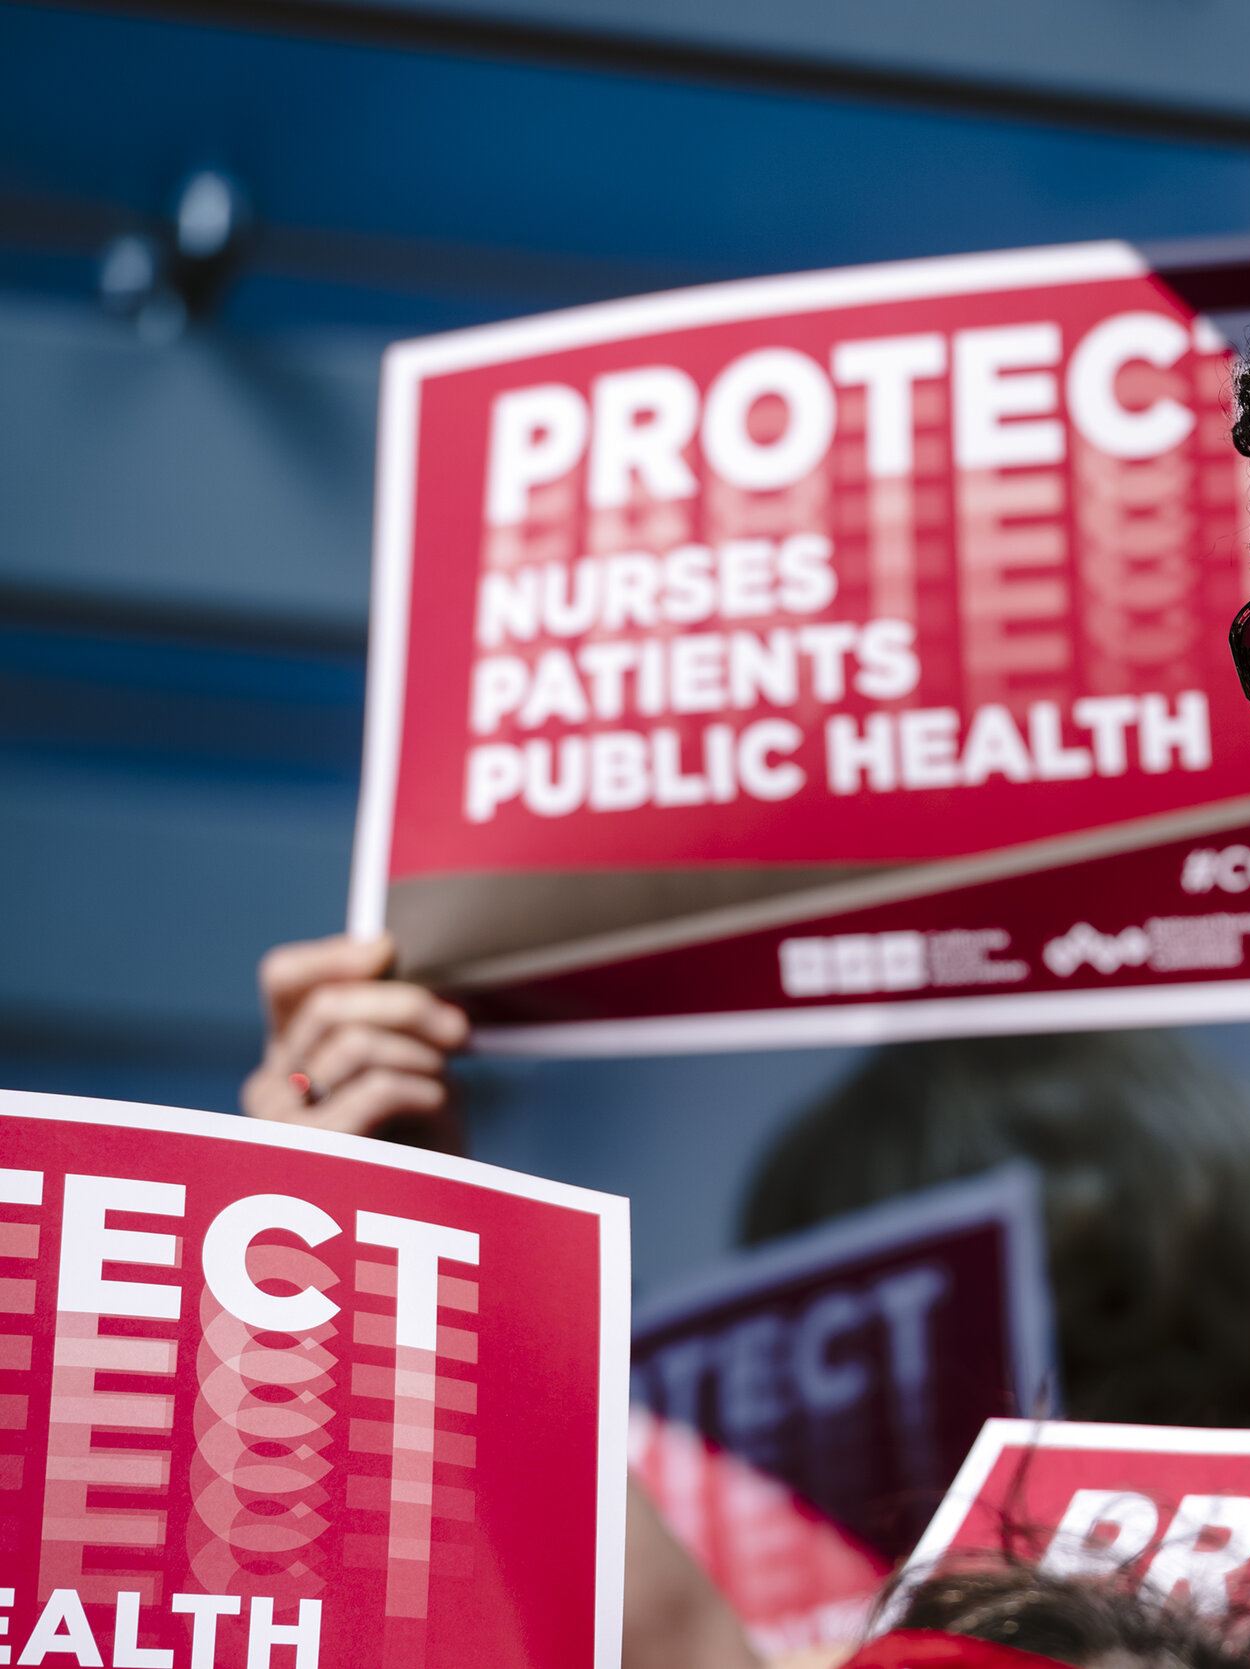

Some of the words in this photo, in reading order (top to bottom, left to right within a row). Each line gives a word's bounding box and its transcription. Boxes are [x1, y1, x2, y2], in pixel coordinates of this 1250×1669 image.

[478, 533, 837, 646] NURSES
[470, 622, 918, 735] PATIENTS
[466, 719, 803, 821] PUBLIC
[827, 692, 1211, 793] HEALTH
[0, 1587, 322, 1669] ALTH
